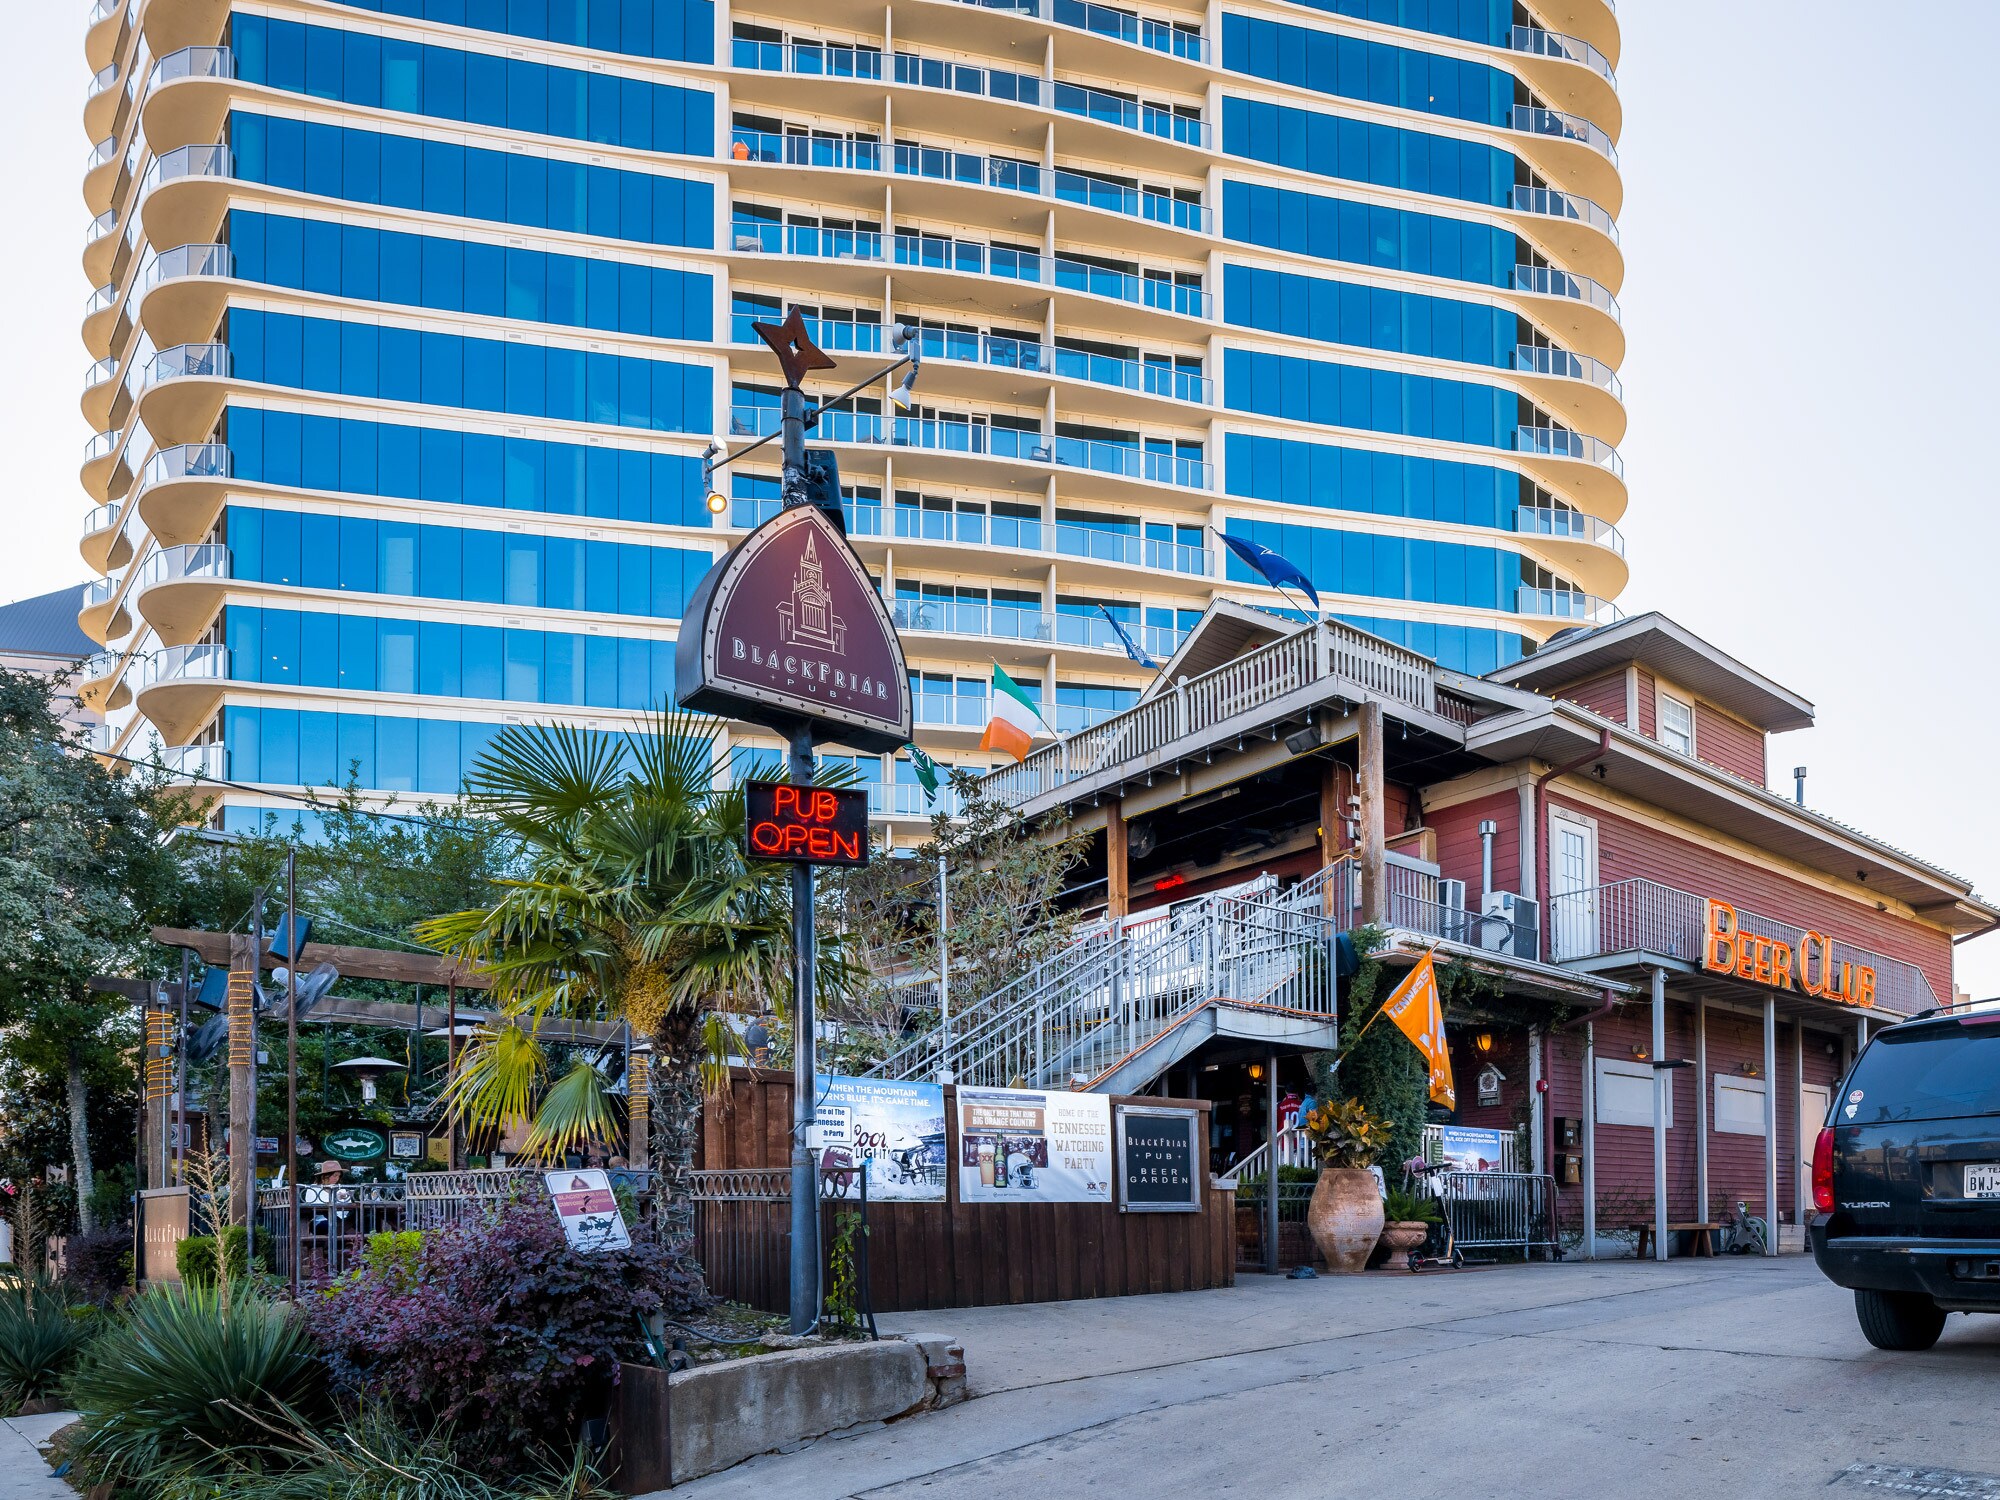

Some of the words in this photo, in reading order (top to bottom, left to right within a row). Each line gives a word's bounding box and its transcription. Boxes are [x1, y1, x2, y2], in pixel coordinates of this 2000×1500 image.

[732, 636, 888, 700] BLACKFRIAR
[787, 678, 837, 698] PUB
[775, 786, 837, 820] PUB
[753, 822, 860, 860] OPEN
[1702, 897, 1792, 990] BEER
[1798, 929, 1877, 1009] CLUB
[828, 1083, 854, 1093] WHEN
[856, 1085, 872, 1094] THE
[873, 1087, 918, 1097] MOUNTAIN
[847, 1094, 870, 1104] BLUE,
[885, 1097, 910, 1106] GAME
[910, 1098, 931, 1107] TIME.
[835, 1108, 845, 1116] The
[1058, 1108, 1075, 1117] HOME
[1077, 1109, 1085, 1117] OF
[1087, 1109, 1099, 1118] THE
[817, 1119, 845, 1127] nnessee
[984, 1117, 1009, 1126] ORANGE
[1010, 1117, 1036, 1127] COUNTRY
[829, 1129, 844, 1138] Party
[1052, 1121, 1106, 1136] TENNESSEE
[357, 1132, 374, 1141] Head
[853, 1123, 889, 1149] Coor
[1128, 1136, 1187, 1148] BLACKFRIAR
[1055, 1139, 1104, 1153] WATCHING
[855, 1147, 887, 1159] LIGHT
[1145, 1152, 1172, 1160] PUB
[1064, 1157, 1095, 1170] PARTY
[1140, 1167, 1178, 1176] BEER
[1129, 1176, 1189, 1184] GARDEN
[1970, 1176, 1993, 1191] BWJ
[558, 1199, 587, 1208] CUSTOM
[1841, 1201, 1891, 1209] YUKON
[144, 1223, 186, 1243] BLACKFRIA
